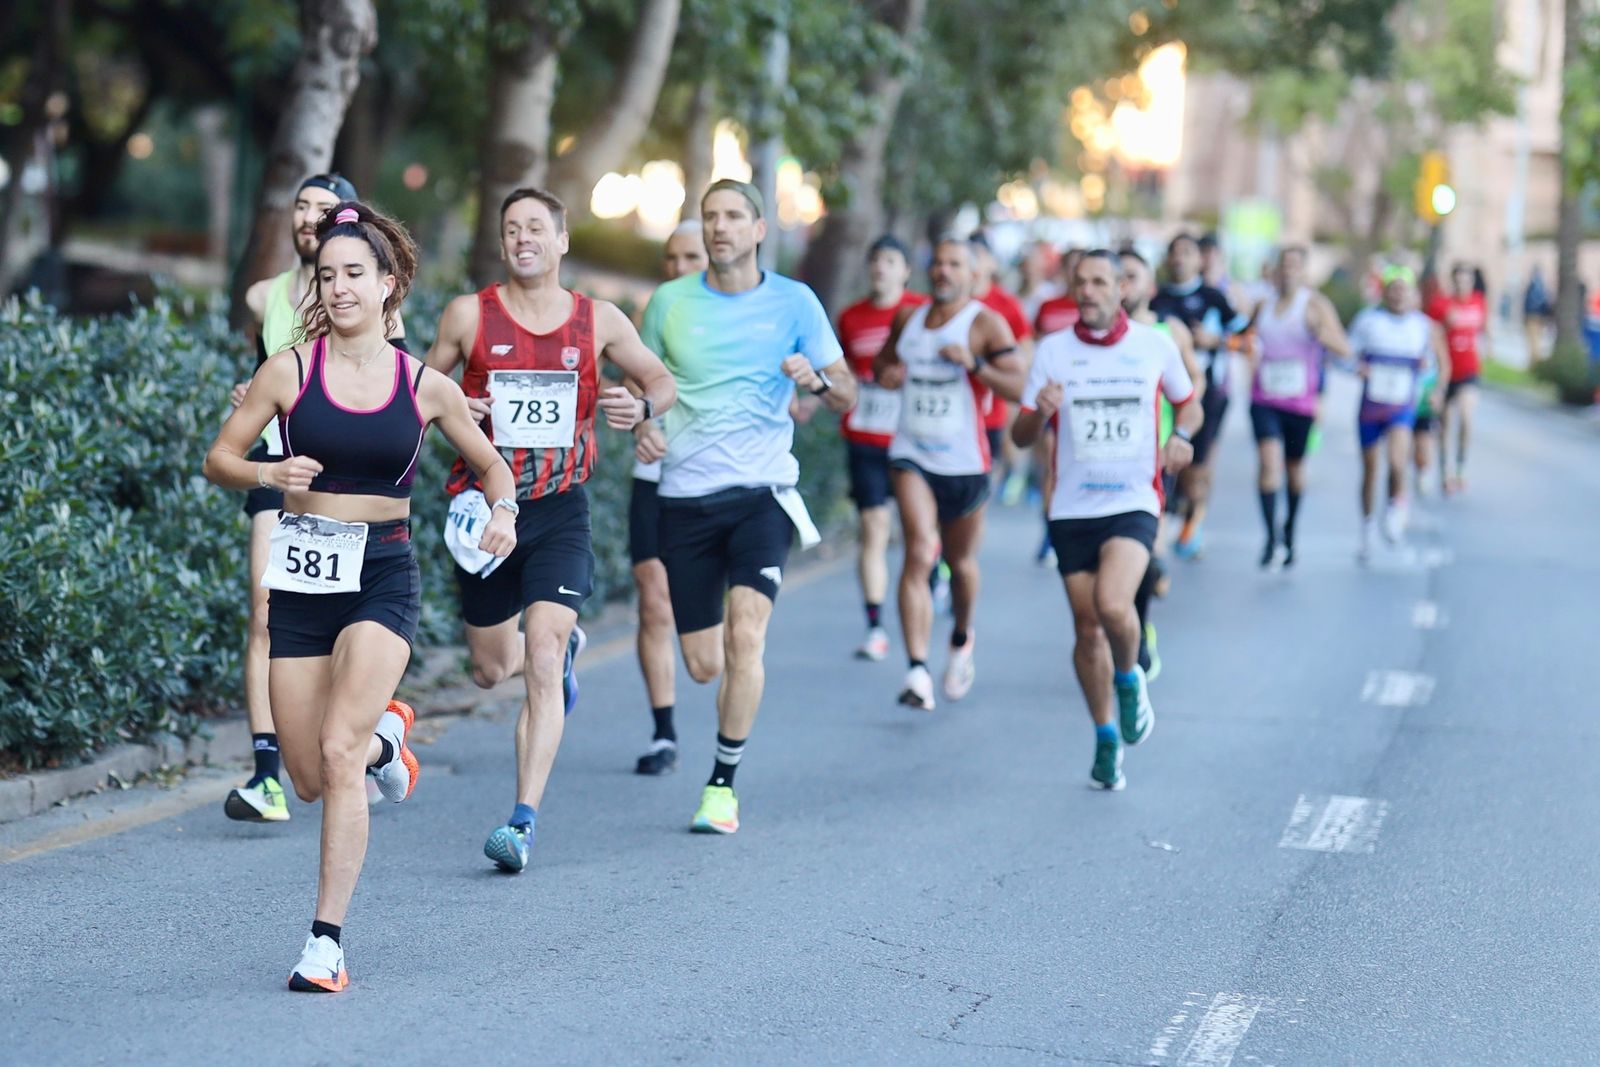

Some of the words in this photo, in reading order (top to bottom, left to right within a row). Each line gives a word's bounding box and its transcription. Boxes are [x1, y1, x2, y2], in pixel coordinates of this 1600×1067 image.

[508, 399, 561, 424] 783
[1086, 418, 1131, 442] 216
[285, 545, 341, 582] 581
